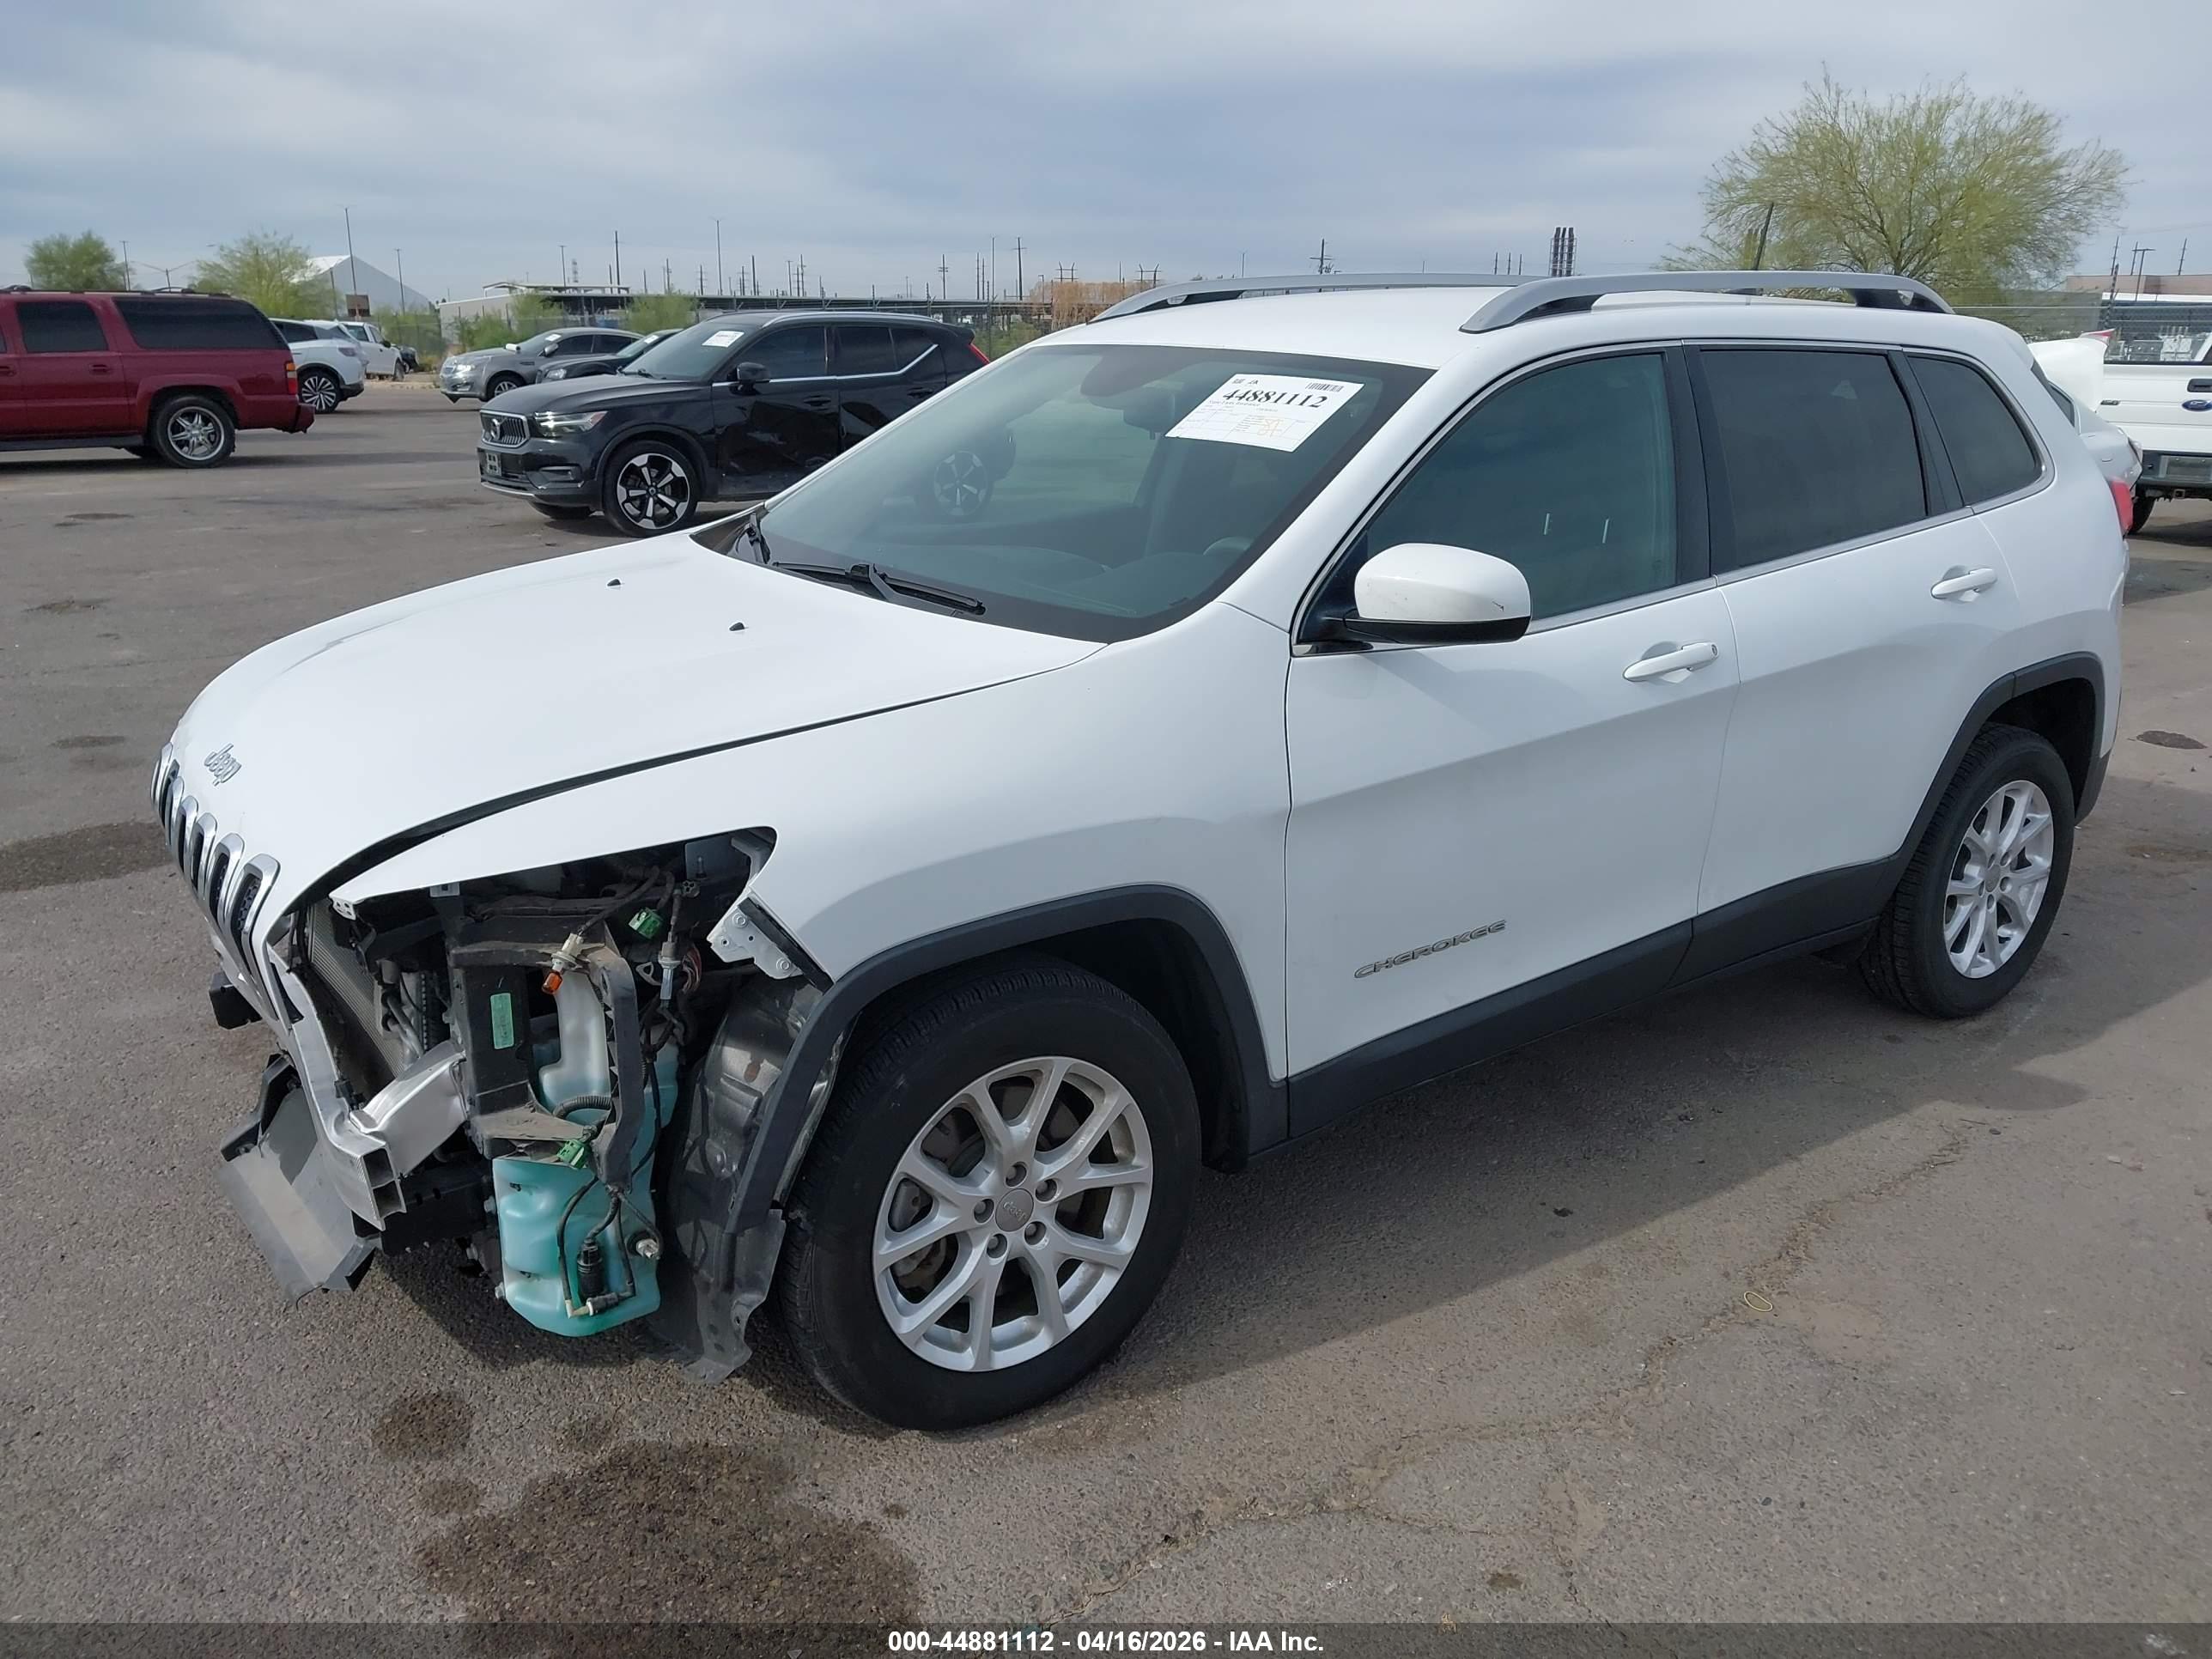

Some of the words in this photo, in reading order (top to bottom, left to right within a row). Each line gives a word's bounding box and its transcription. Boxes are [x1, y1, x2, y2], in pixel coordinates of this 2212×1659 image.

[1223, 389, 1328, 408] 44881112
[204, 743, 241, 787] Jeep
[1354, 919, 1506, 979] CHEROKEE
